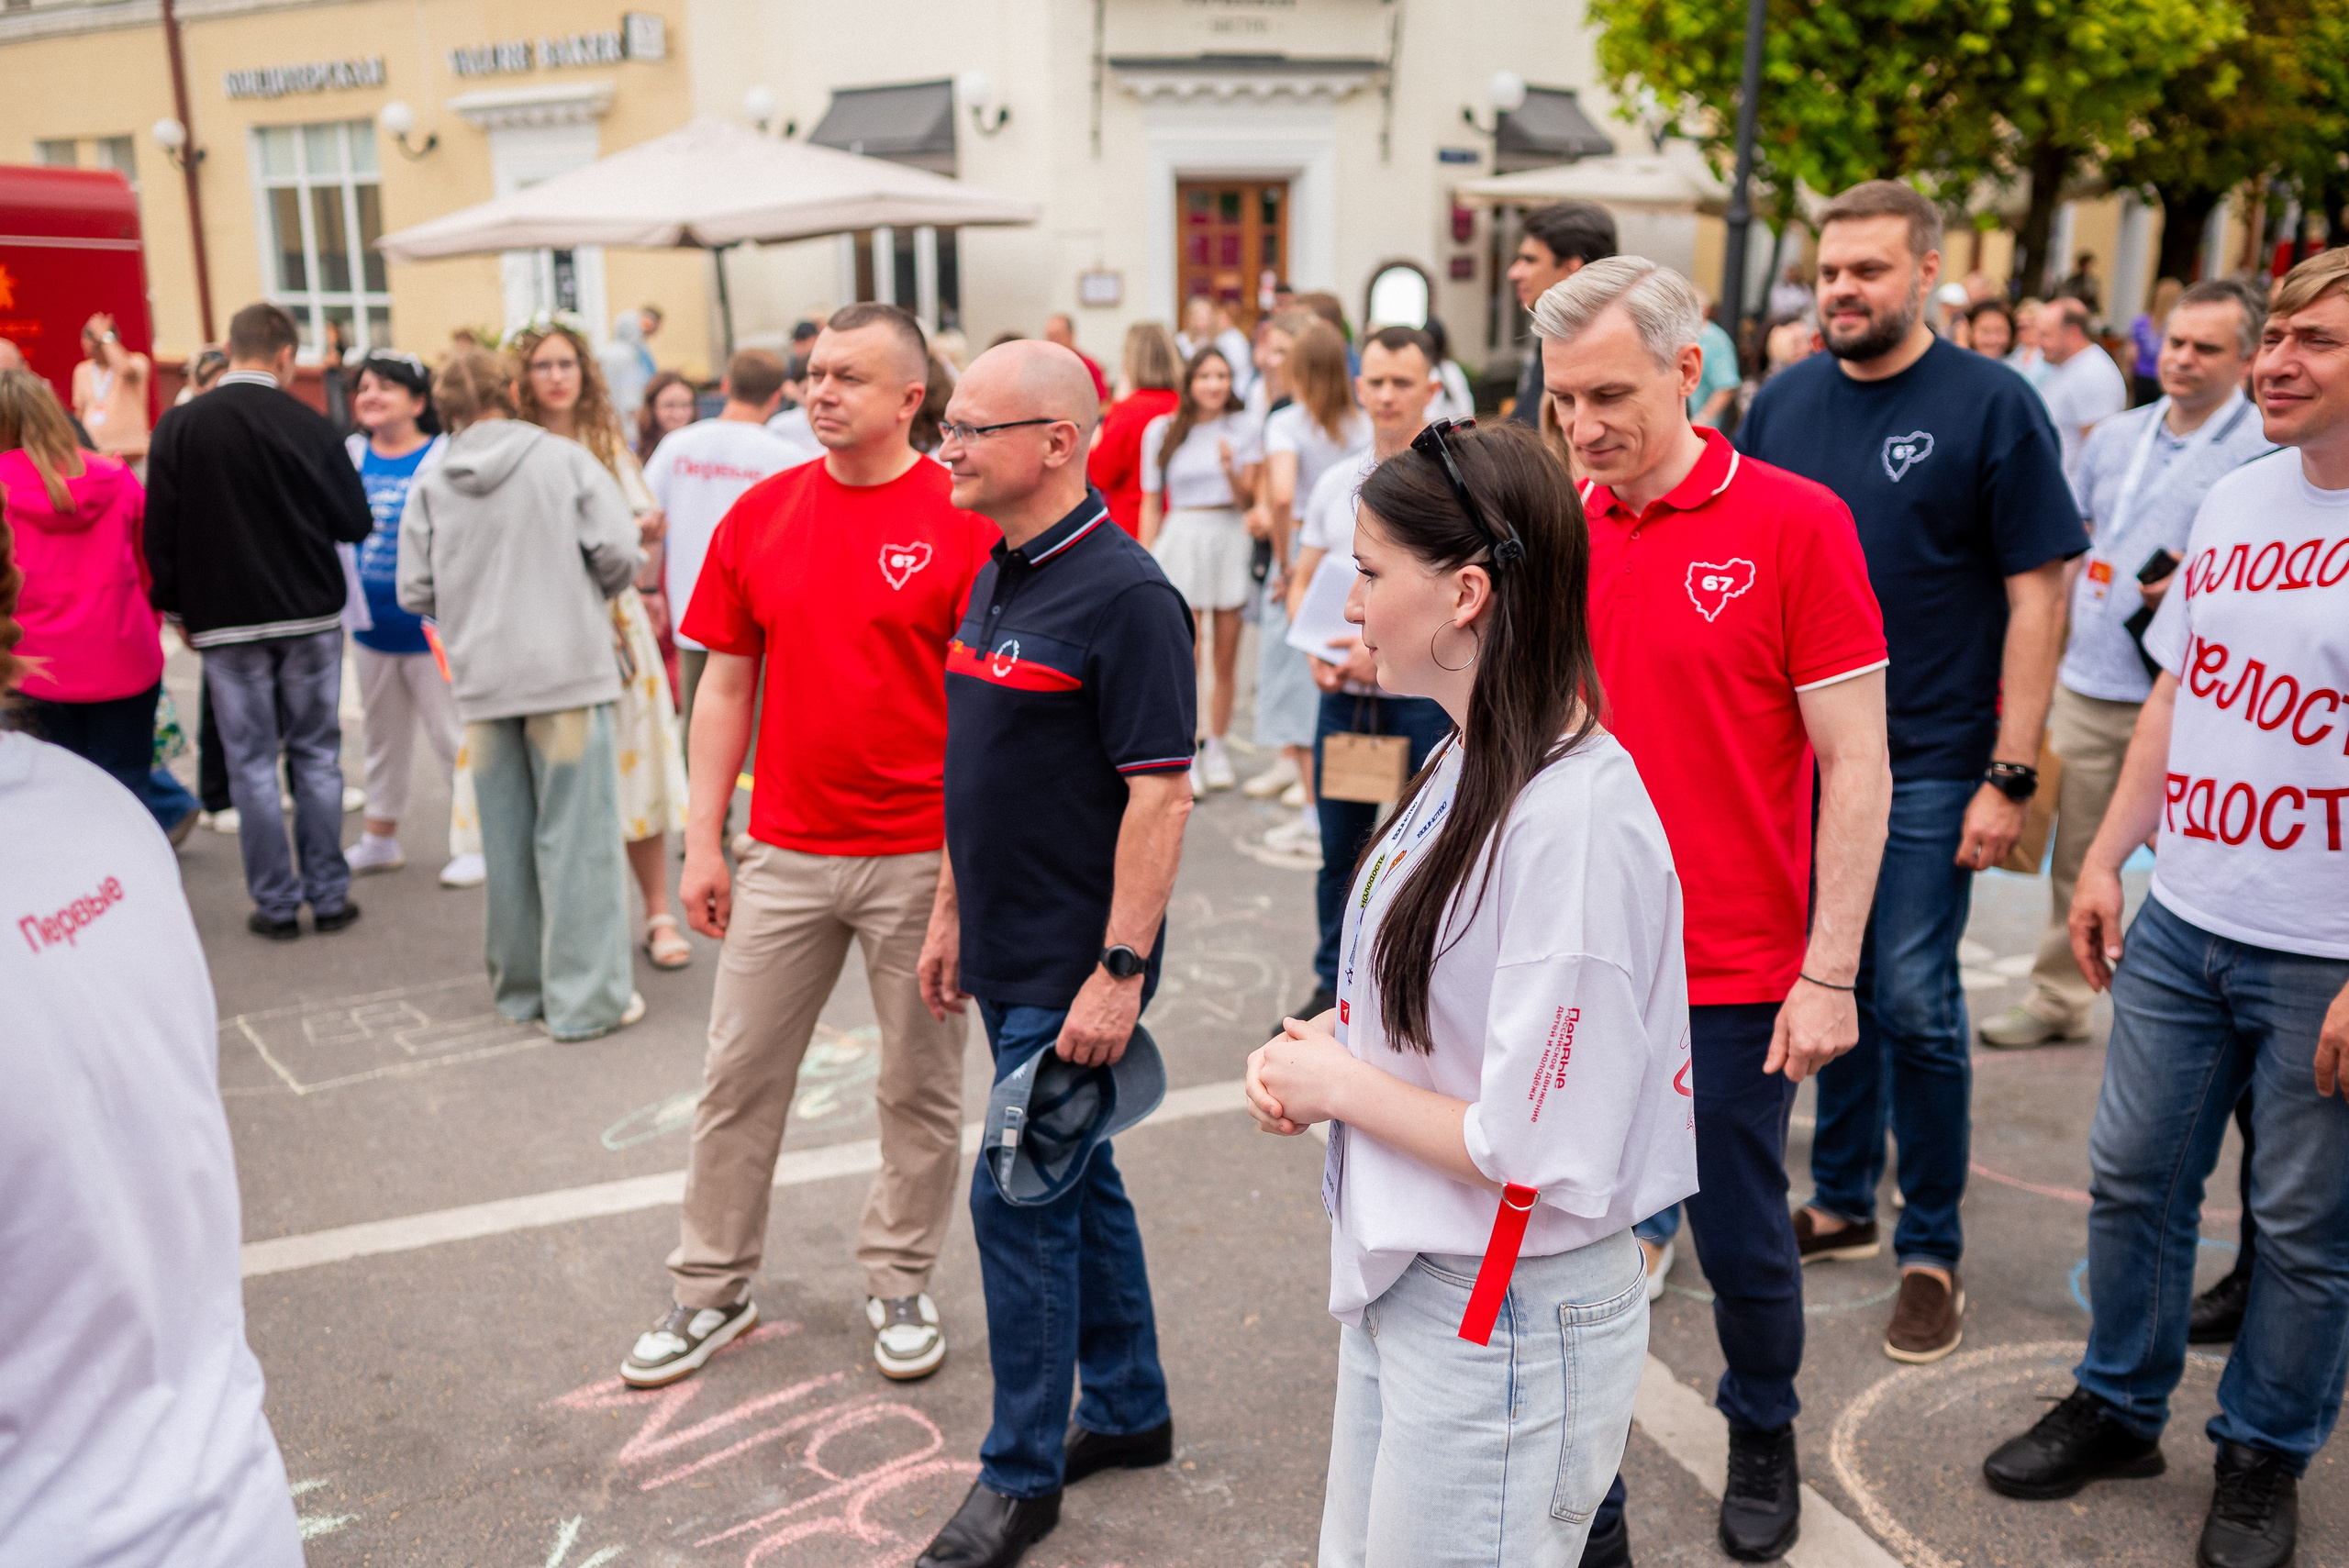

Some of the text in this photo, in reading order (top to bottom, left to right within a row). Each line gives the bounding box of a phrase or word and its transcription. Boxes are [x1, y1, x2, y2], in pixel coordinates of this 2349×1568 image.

[890, 553, 917, 568] 67
[1701, 575, 1734, 592] 67
[17, 875, 123, 953] Первые
[1550, 1006, 1564, 1038] детей
[1531, 1072, 1553, 1122] движение
